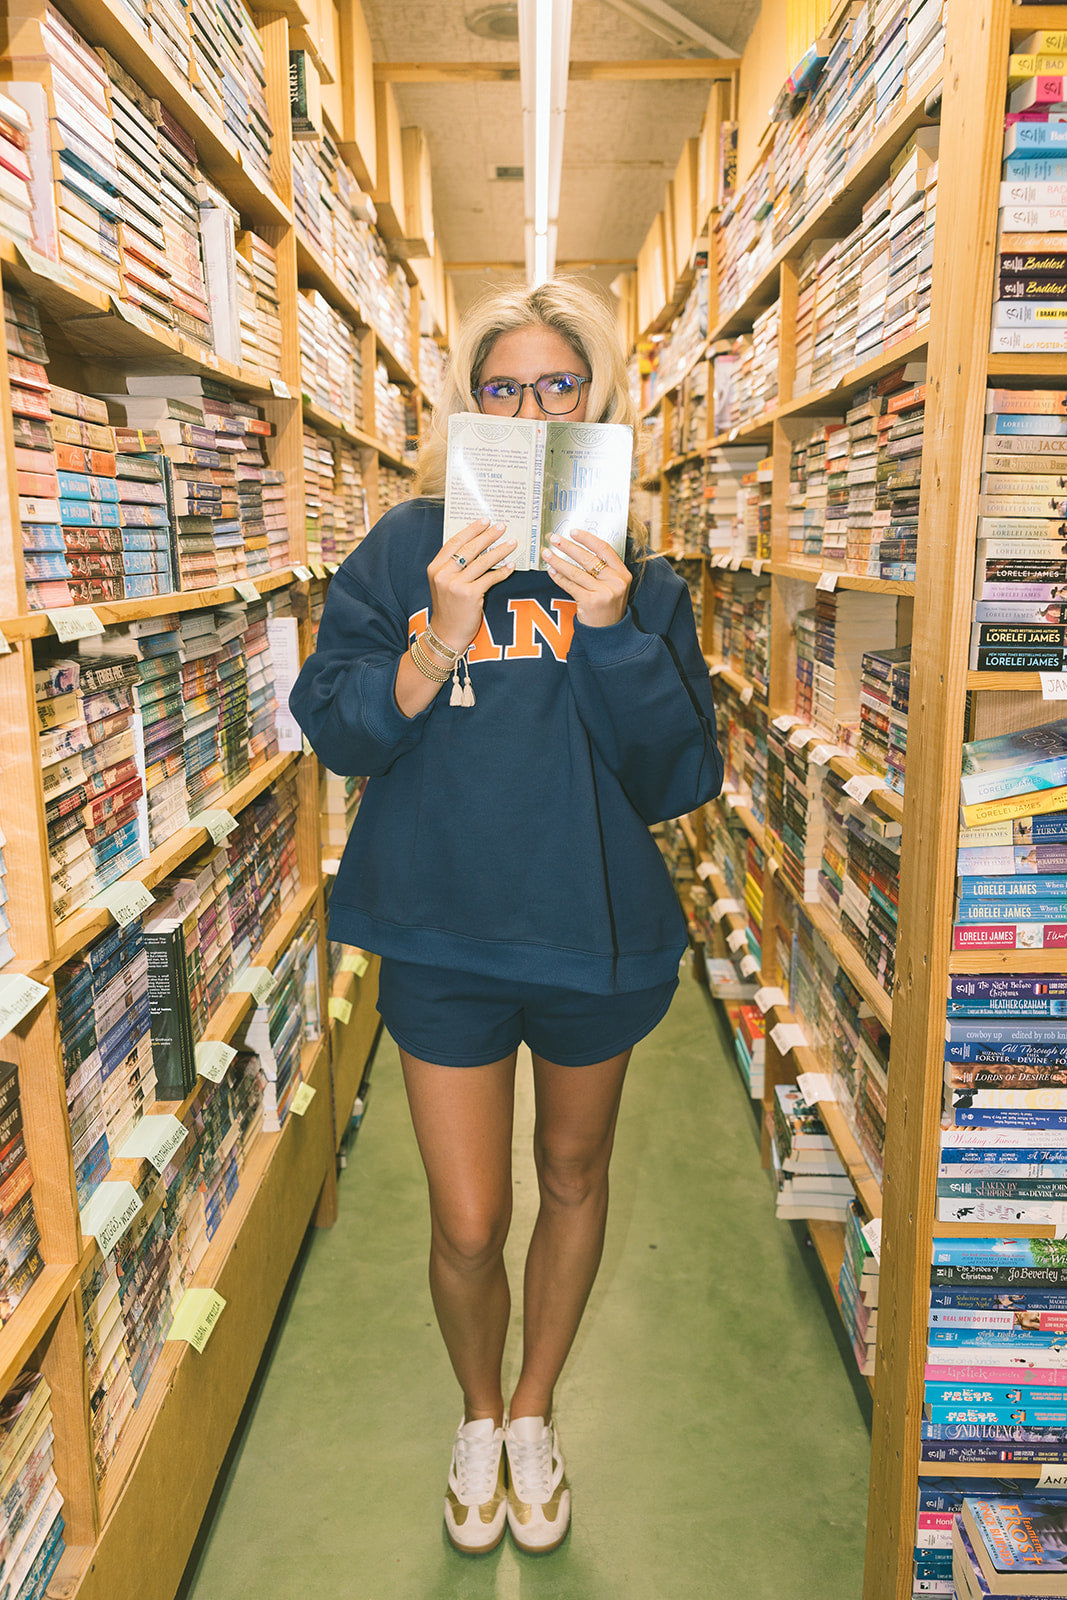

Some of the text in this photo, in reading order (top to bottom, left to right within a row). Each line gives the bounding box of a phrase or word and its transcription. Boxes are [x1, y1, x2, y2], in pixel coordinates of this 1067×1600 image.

[1045, 60, 1064, 70] BAD
[290, 63, 298, 103] SECRETS
[1024, 256, 1066, 270] Baddest
[1026, 282, 1067, 294] Baddest
[550, 482, 622, 512] JOHSEN
[1018, 505, 1042, 513] JAMES
[986, 633, 1060, 642] LORELEI JAMES
[986, 657, 1059, 666] LORELEI JAMES
[978, 776, 1042, 796] LORELEI JAMES
[976, 801, 1042, 819] LORELEI JAMES
[974, 884, 1037, 896] LORELEI JAMES
[968, 908, 1001, 918] LORELEI
[1003, 907, 1032, 918] JAMES
[960, 932, 1014, 941] LORELEI JAMES
[977, 980, 1032, 990] The Night Before
[989, 989, 1019, 997] Christmas
[990, 1000, 1047, 1009] HEATHER GRAHAM
[966, 1031, 991, 1040] cowboy
[994, 1032, 1002, 1040] up
[1012, 1031, 1032, 1039] edited
[1034, 1031, 1042, 1041] by
[1001, 1044, 1058, 1057] All Through
[982, 1090, 1026, 1107] KICK
[948, 1133, 987, 1146] Wedding
[988, 1134, 1019, 1145] Favors
[981, 1181, 1005, 1190] TAKEN
[975, 1187, 1013, 1197] SURPRISE
[100, 1216, 122, 1250] GRIGGS,
[1008, 1268, 1058, 1282] Jo Beverley
[947, 1367, 988, 1379] Lipstick
[945, 1424, 1022, 1440] INDULGENCE
[977, 1500, 1014, 1566] ONCE BURNED
[998, 1504, 1044, 1566] FROST
[1020, 1516, 1044, 1554] JEANIENE
